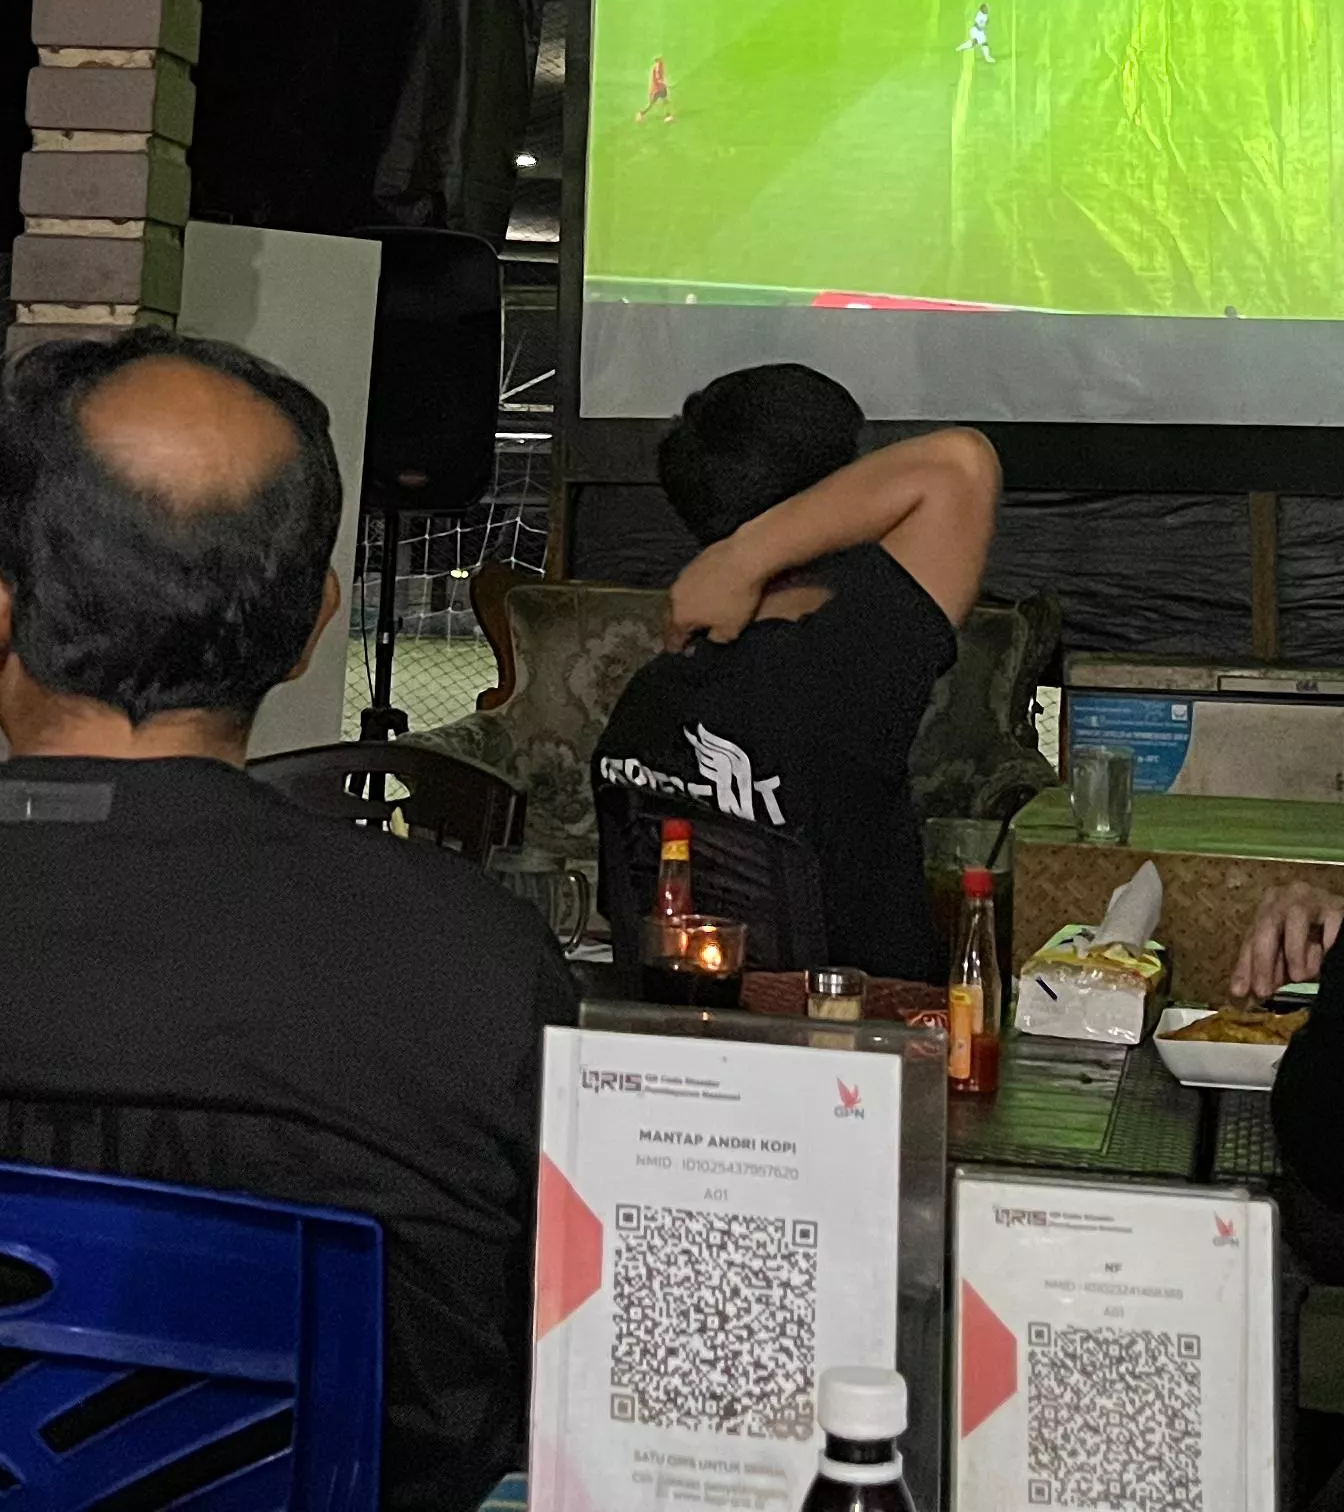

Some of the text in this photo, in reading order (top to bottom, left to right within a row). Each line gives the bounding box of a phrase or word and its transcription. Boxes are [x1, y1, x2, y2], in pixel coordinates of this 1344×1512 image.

[639, 1129, 797, 1154] MANTAP ANDRI KOPI
